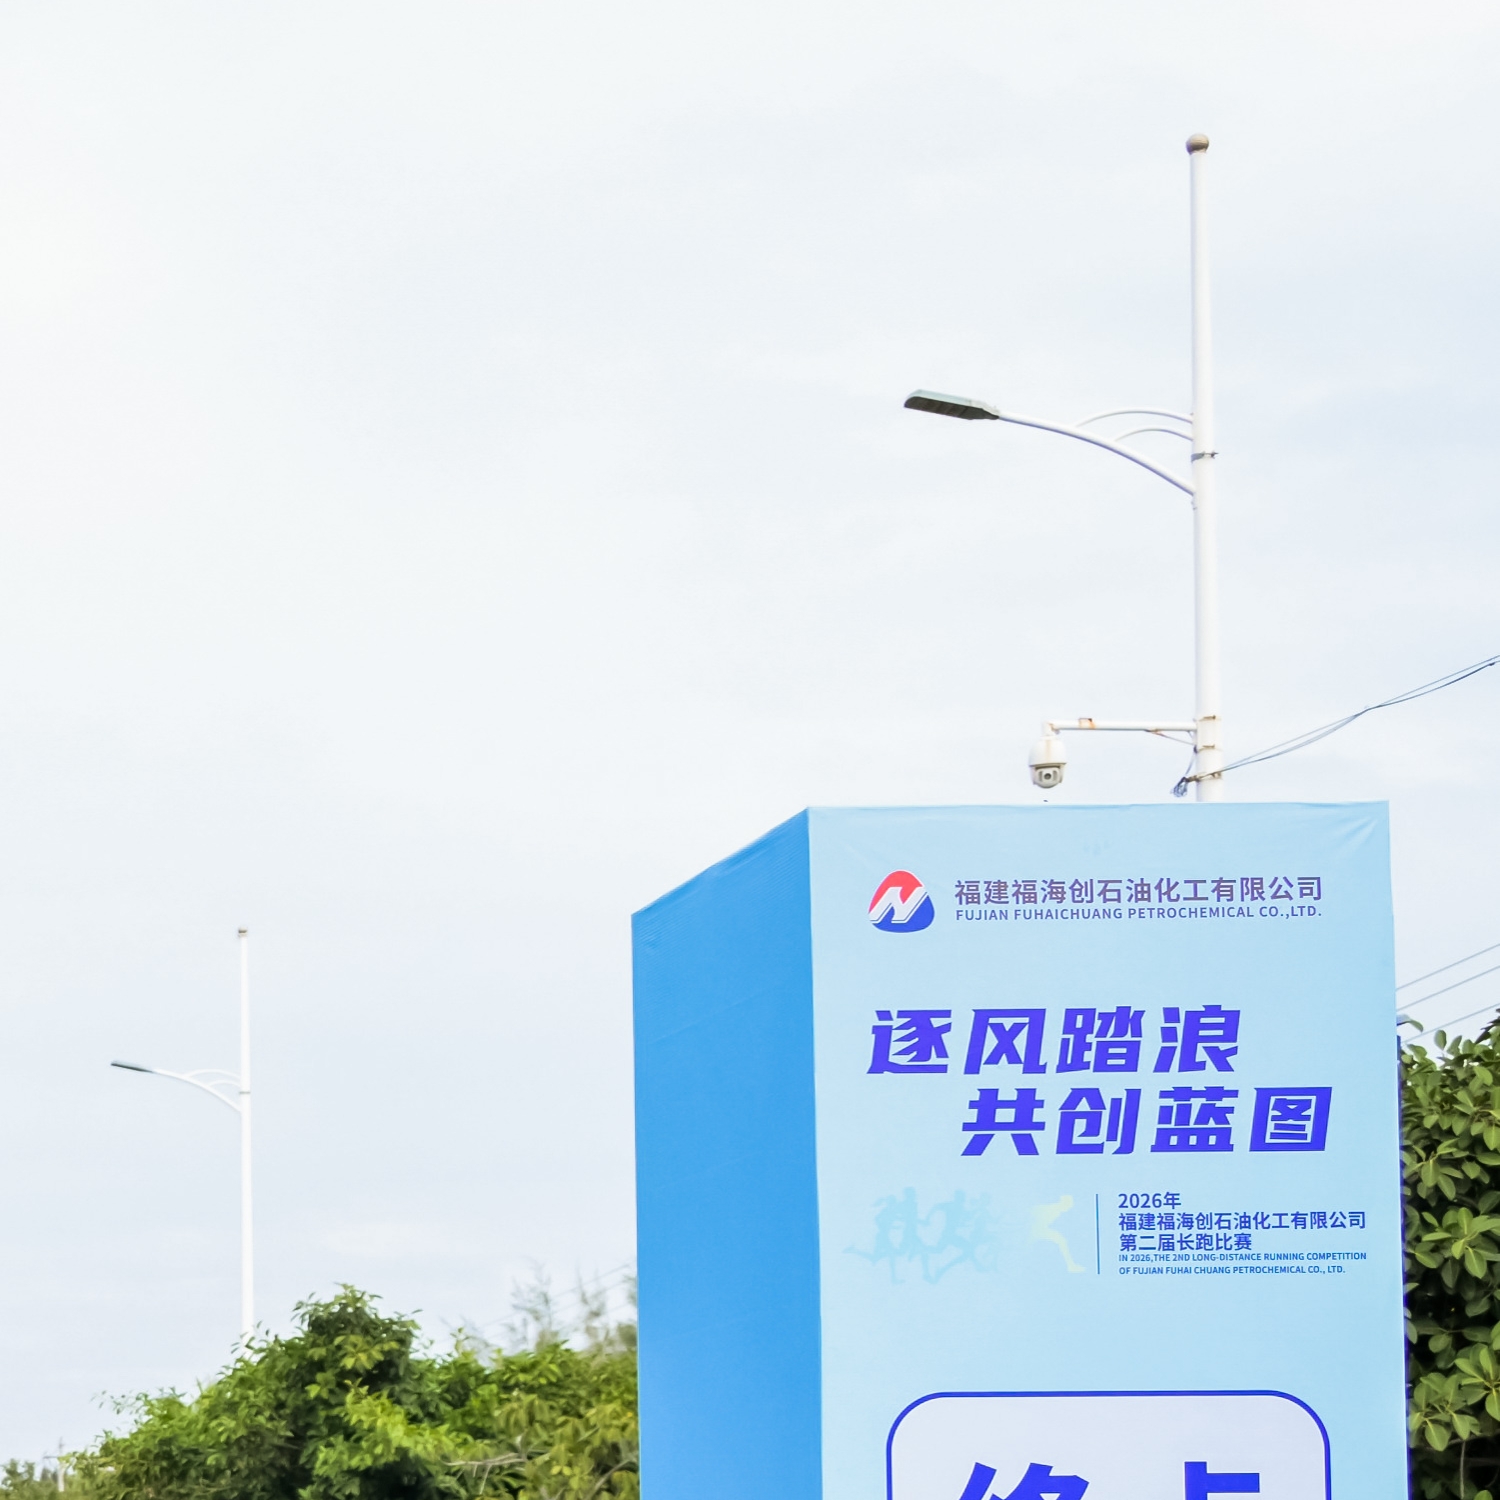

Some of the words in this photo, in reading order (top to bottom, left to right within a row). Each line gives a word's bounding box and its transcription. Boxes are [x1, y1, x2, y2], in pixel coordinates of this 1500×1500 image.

[955, 877, 1321, 905] 福建福海创石油化工有限公司
[956, 909, 1008, 921] FUJIAN
[1015, 908, 1122, 920] FUHAICHUANG
[1128, 906, 1254, 919] PETROCHEMICAL
[1259, 905, 1321, 919] CO.,LTD.
[867, 1005, 1240, 1075] 逐风踏浪
[961, 1086, 1332, 1156] 共创蓝图
[1118, 1192, 1181, 1209] 2026年
[1119, 1211, 1365, 1231] 福建福海创石油化工有限公司
[1120, 1231, 1252, 1252] 第二届长跑比赛
[1119, 1254, 1127, 1262] IN
[1172, 1254, 1190, 1262] 2ND
[1192, 1253, 1261, 1262] LONG-DISTANCE
[1263, 1253, 1304, 1261] RUNNING
[1306, 1252, 1367, 1261] COMPETITION
[1119, 1266, 1131, 1275] OF
[1133, 1266, 1164, 1275] FUJIAN
[1166, 1266, 1192, 1275] FUHAI
[1194, 1266, 1231, 1275] CHUANG
[1232, 1265, 1306, 1274] PETROCHEMICAL
[1327, 1265, 1346, 1274] LTD.
